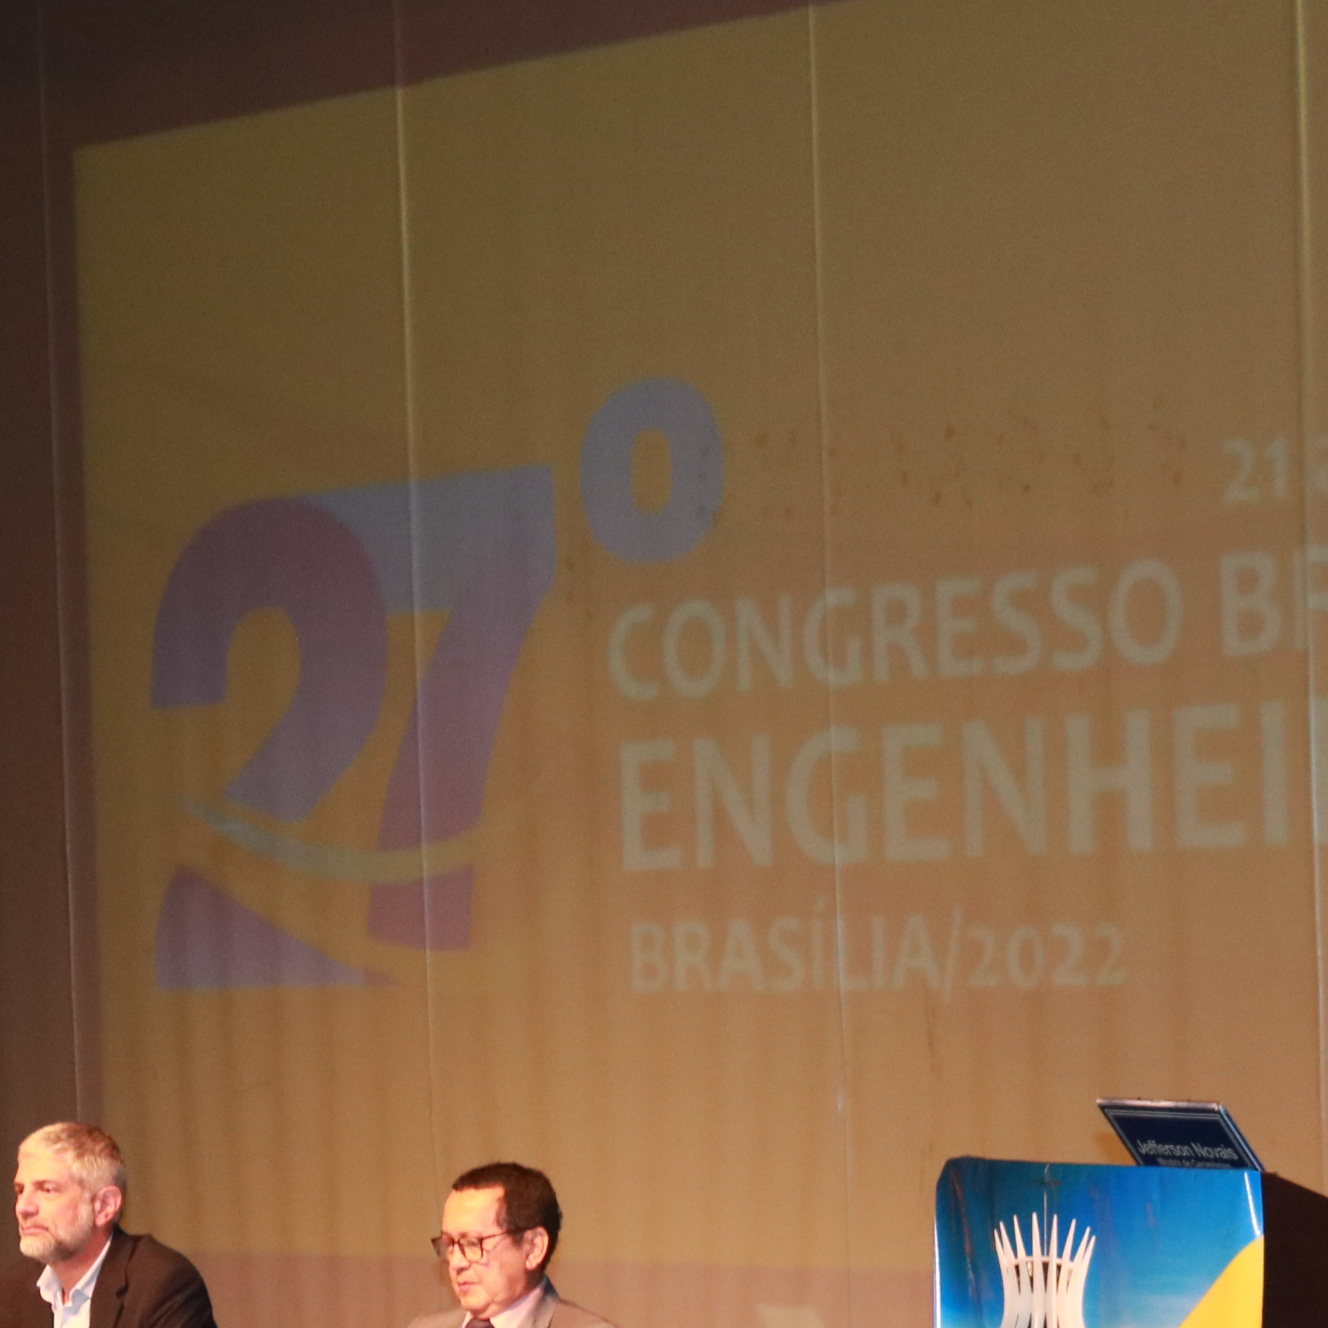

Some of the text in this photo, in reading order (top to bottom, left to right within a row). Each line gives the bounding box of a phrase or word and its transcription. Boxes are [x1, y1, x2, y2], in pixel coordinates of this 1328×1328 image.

[1221, 435, 1290, 505] 21
[608, 558, 1183, 699] CONGRESSO
[630, 896, 1128, 1007] BRASÍLIA/2022
[1137, 1139, 1239, 1161] Jefferson Novais
